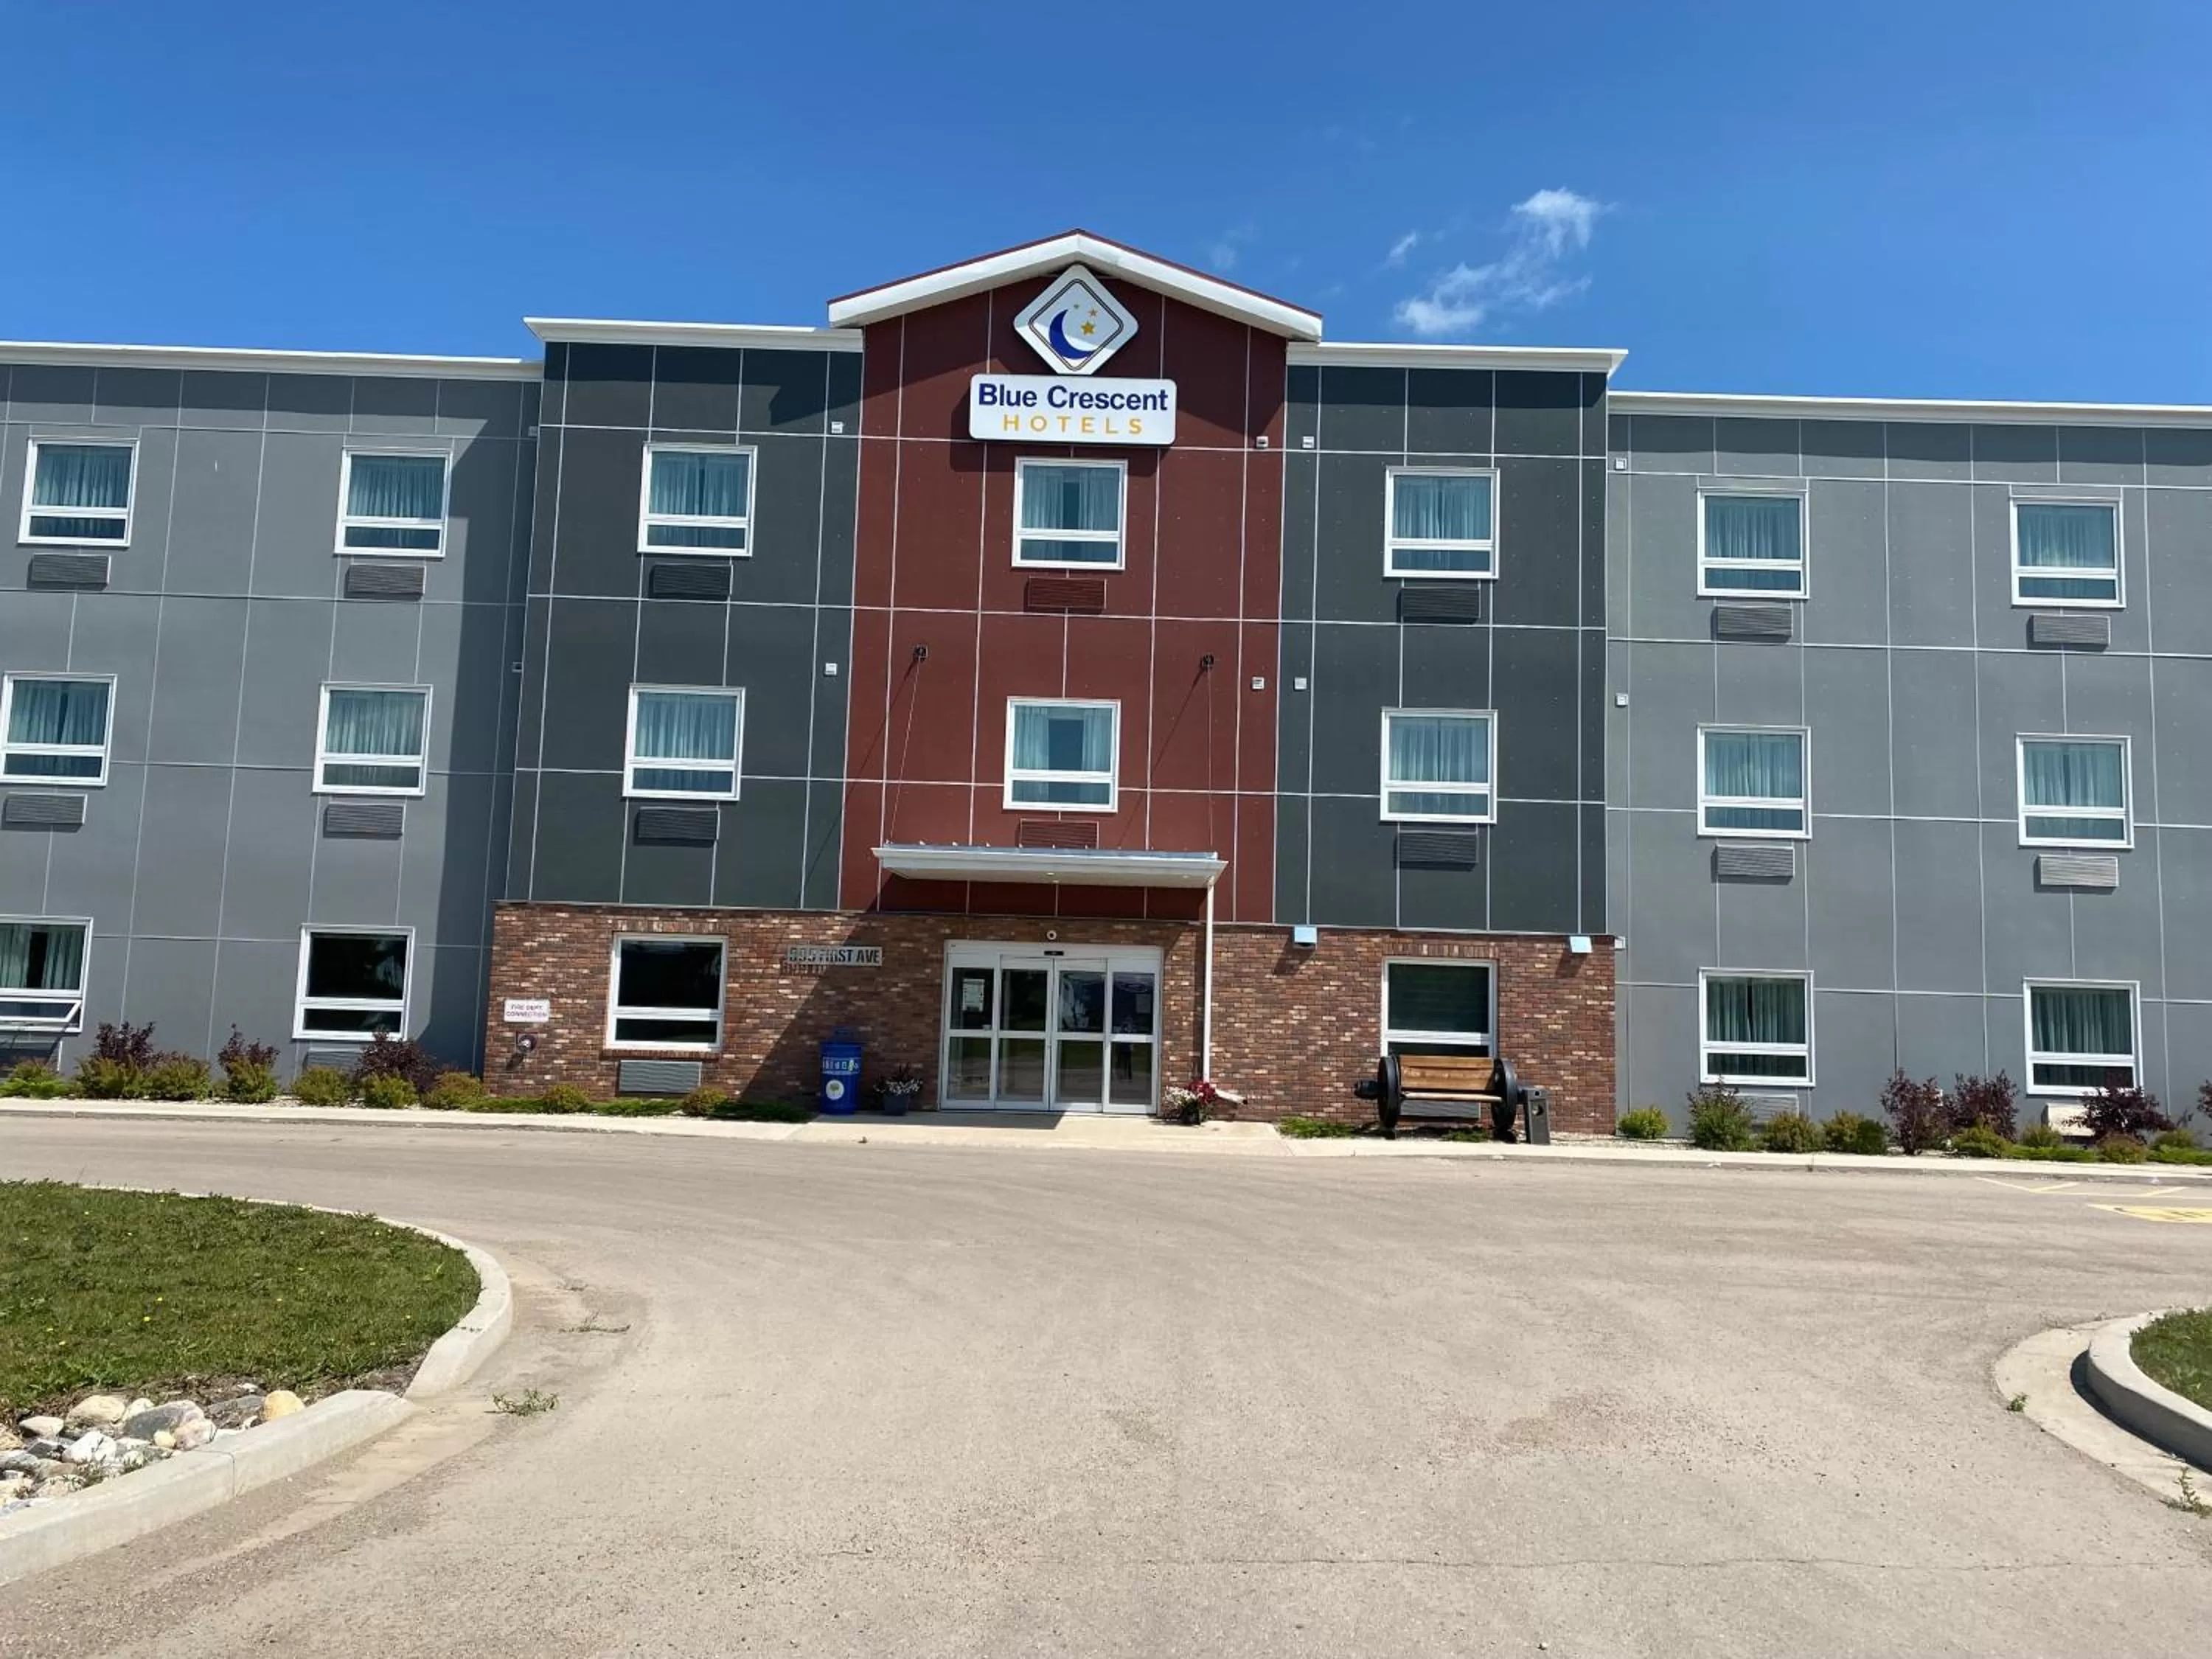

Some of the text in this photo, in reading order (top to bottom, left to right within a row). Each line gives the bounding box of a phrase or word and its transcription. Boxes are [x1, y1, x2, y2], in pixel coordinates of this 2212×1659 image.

[978, 383, 1169, 411] Blue Crescent
[1003, 414, 1142, 434] HOTELS
[819, 949, 854, 962] FIRST
[856, 949, 880, 963] AVE
